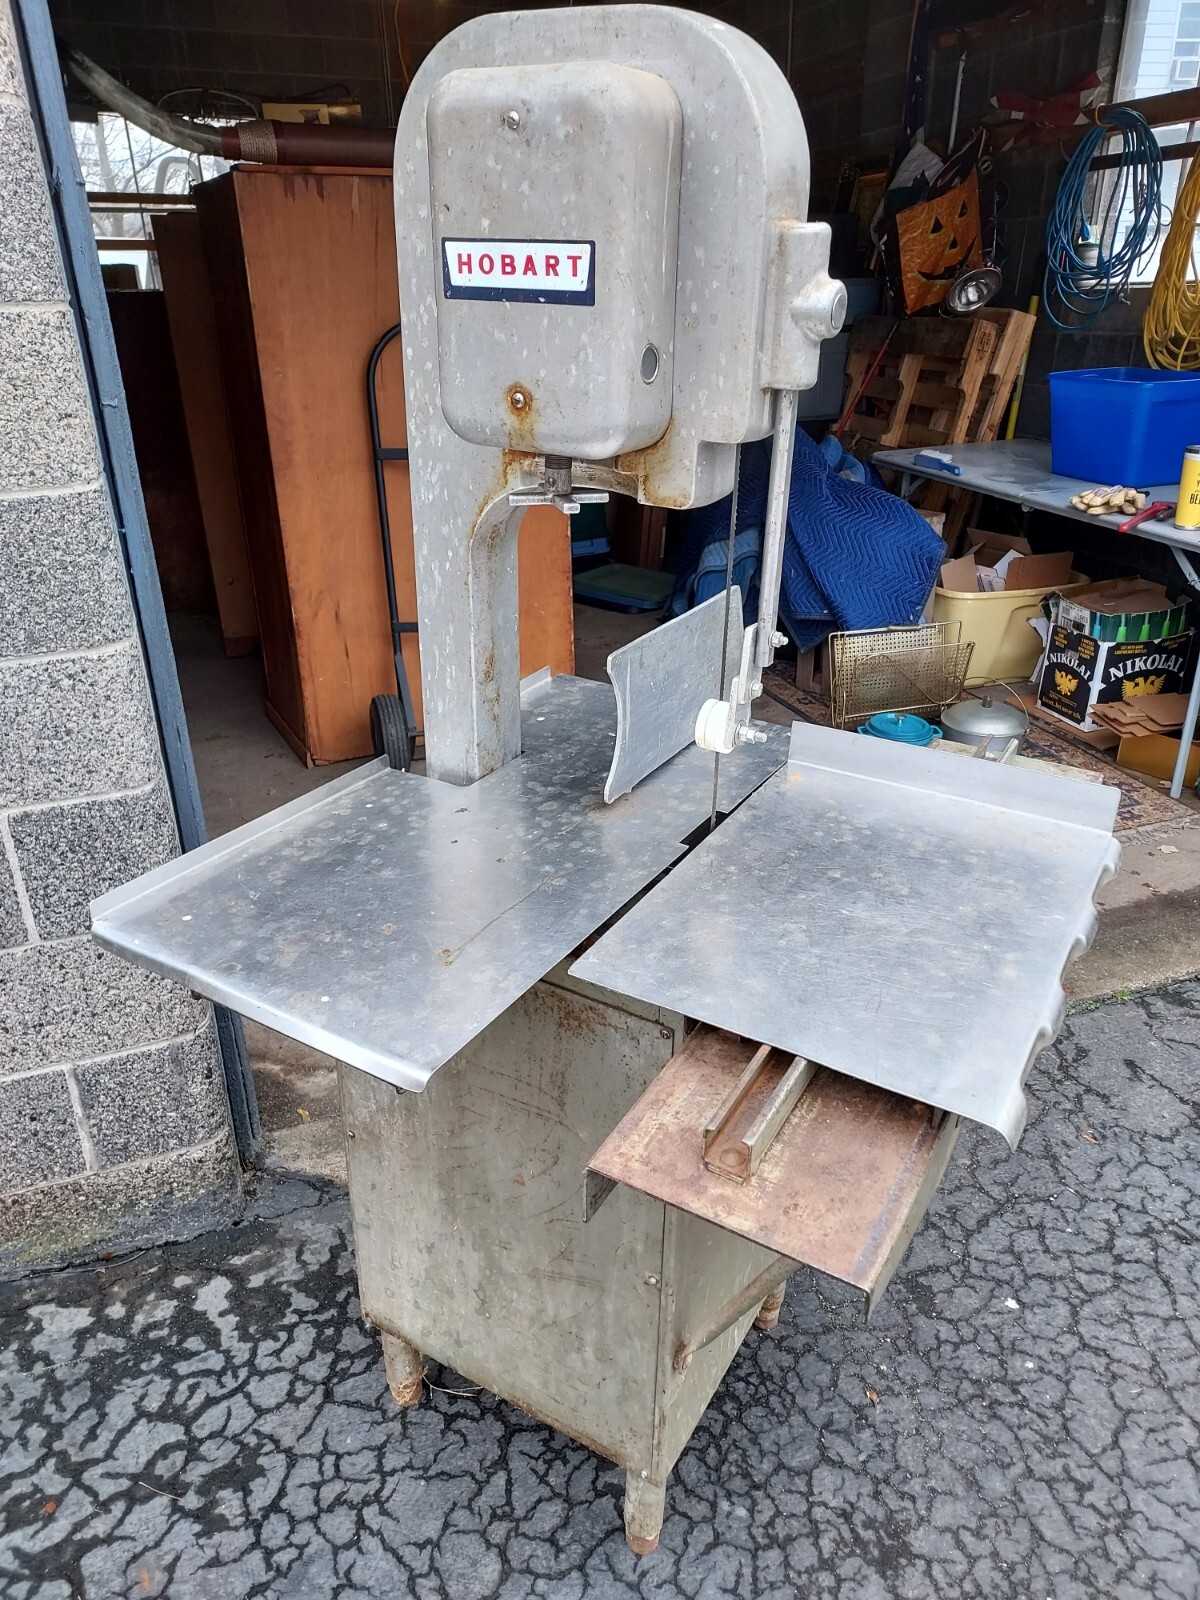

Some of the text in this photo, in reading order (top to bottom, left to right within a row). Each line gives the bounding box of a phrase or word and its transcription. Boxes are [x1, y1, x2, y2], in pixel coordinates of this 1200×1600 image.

[457, 253, 583, 278] HOBART
[1189, 493, 1200, 505] BE
[1049, 652, 1091, 680] NIKOLAI
[1108, 653, 1184, 682] NIKOLAI
